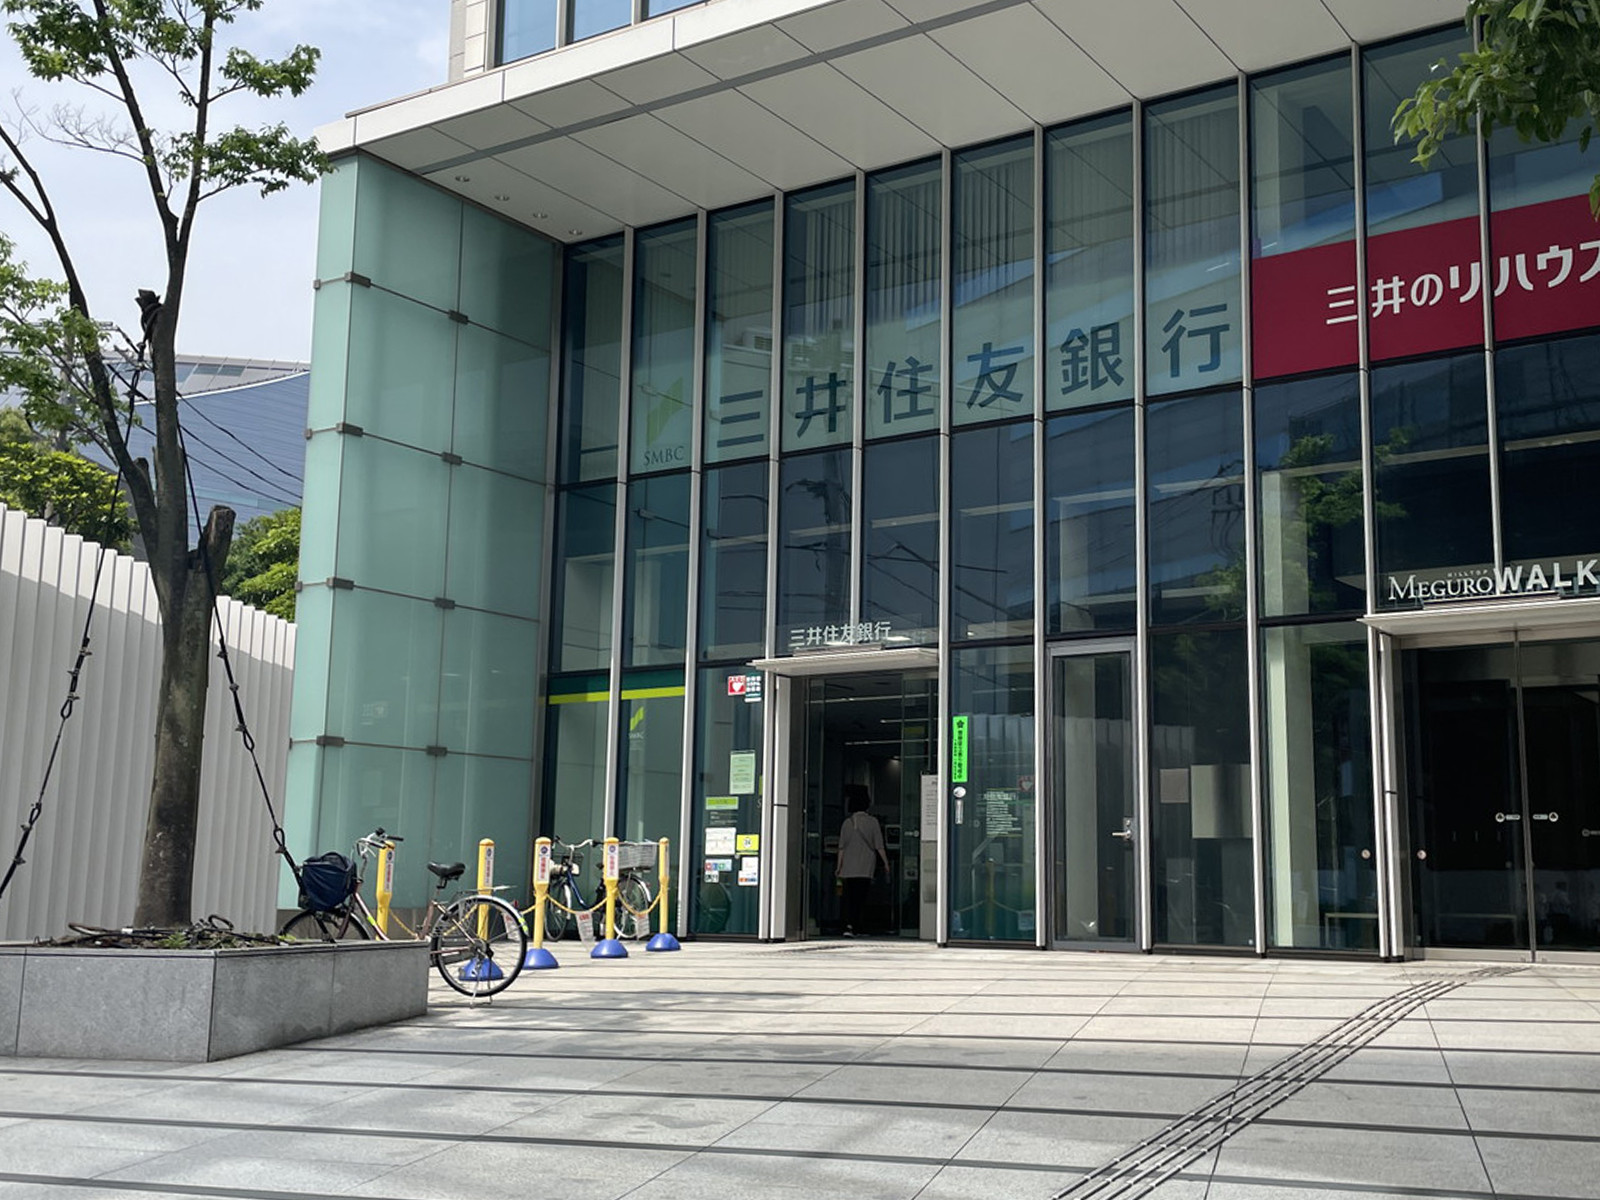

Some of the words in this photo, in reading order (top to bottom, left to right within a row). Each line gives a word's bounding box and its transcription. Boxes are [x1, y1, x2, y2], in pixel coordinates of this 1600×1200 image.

[1326, 240, 1600, 325] 三井のリハウス
[717, 303, 1230, 448] 三井住友銀行
[643, 445, 684, 467] SMBC
[789, 621, 891, 647] 三井住友銀行
